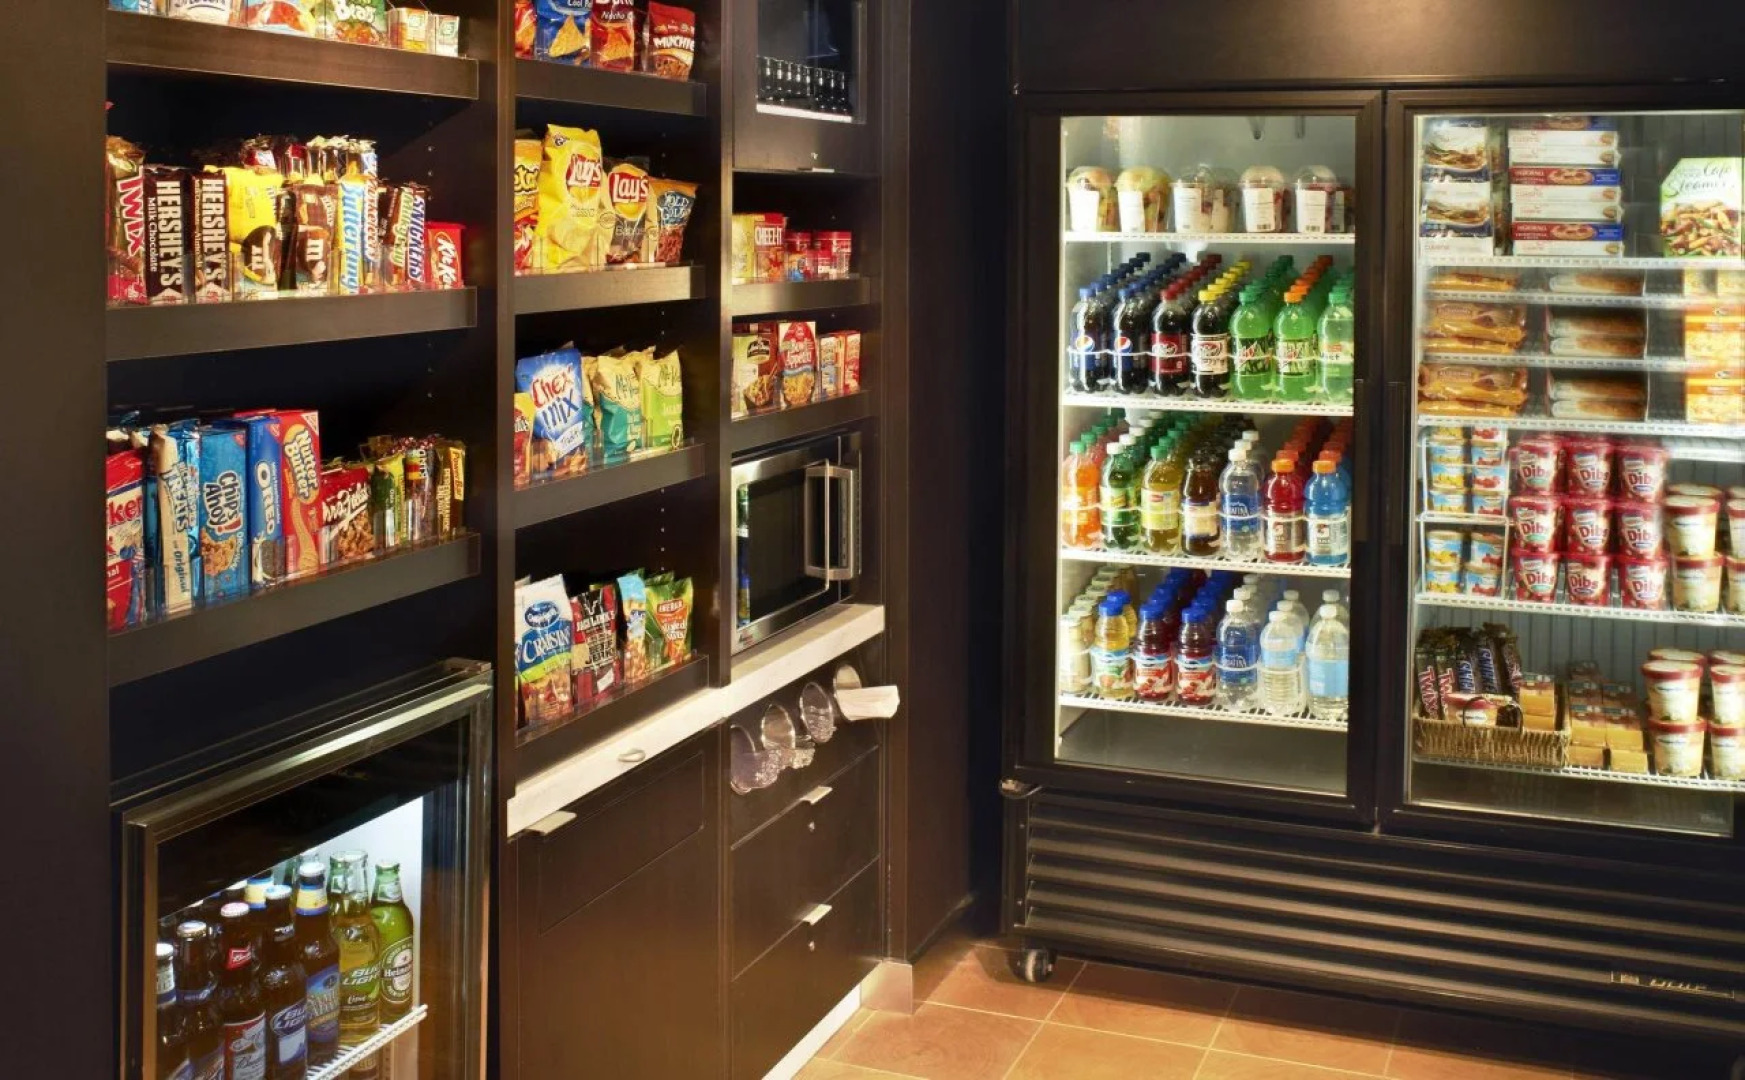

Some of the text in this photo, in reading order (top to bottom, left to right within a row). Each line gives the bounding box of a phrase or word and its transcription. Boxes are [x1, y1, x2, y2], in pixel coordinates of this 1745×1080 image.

[567, 154, 601, 187] Lay's
[612, 173, 649, 204] Lay's
[117, 170, 145, 256] TWIX
[148, 197, 158, 272] Milk Chocolate
[156, 180, 182, 286] HERSHEY'S
[202, 179, 227, 282] HERSHEY'S
[408, 194, 425, 281] SNICKERS
[532, 363, 574, 408] Chex
[284, 441, 309, 500] Butter
[299, 430, 318, 489] Nutter
[219, 470, 241, 521] Chips
[256, 461, 275, 534] OREO
[1571, 574, 1598, 587] Dibs
